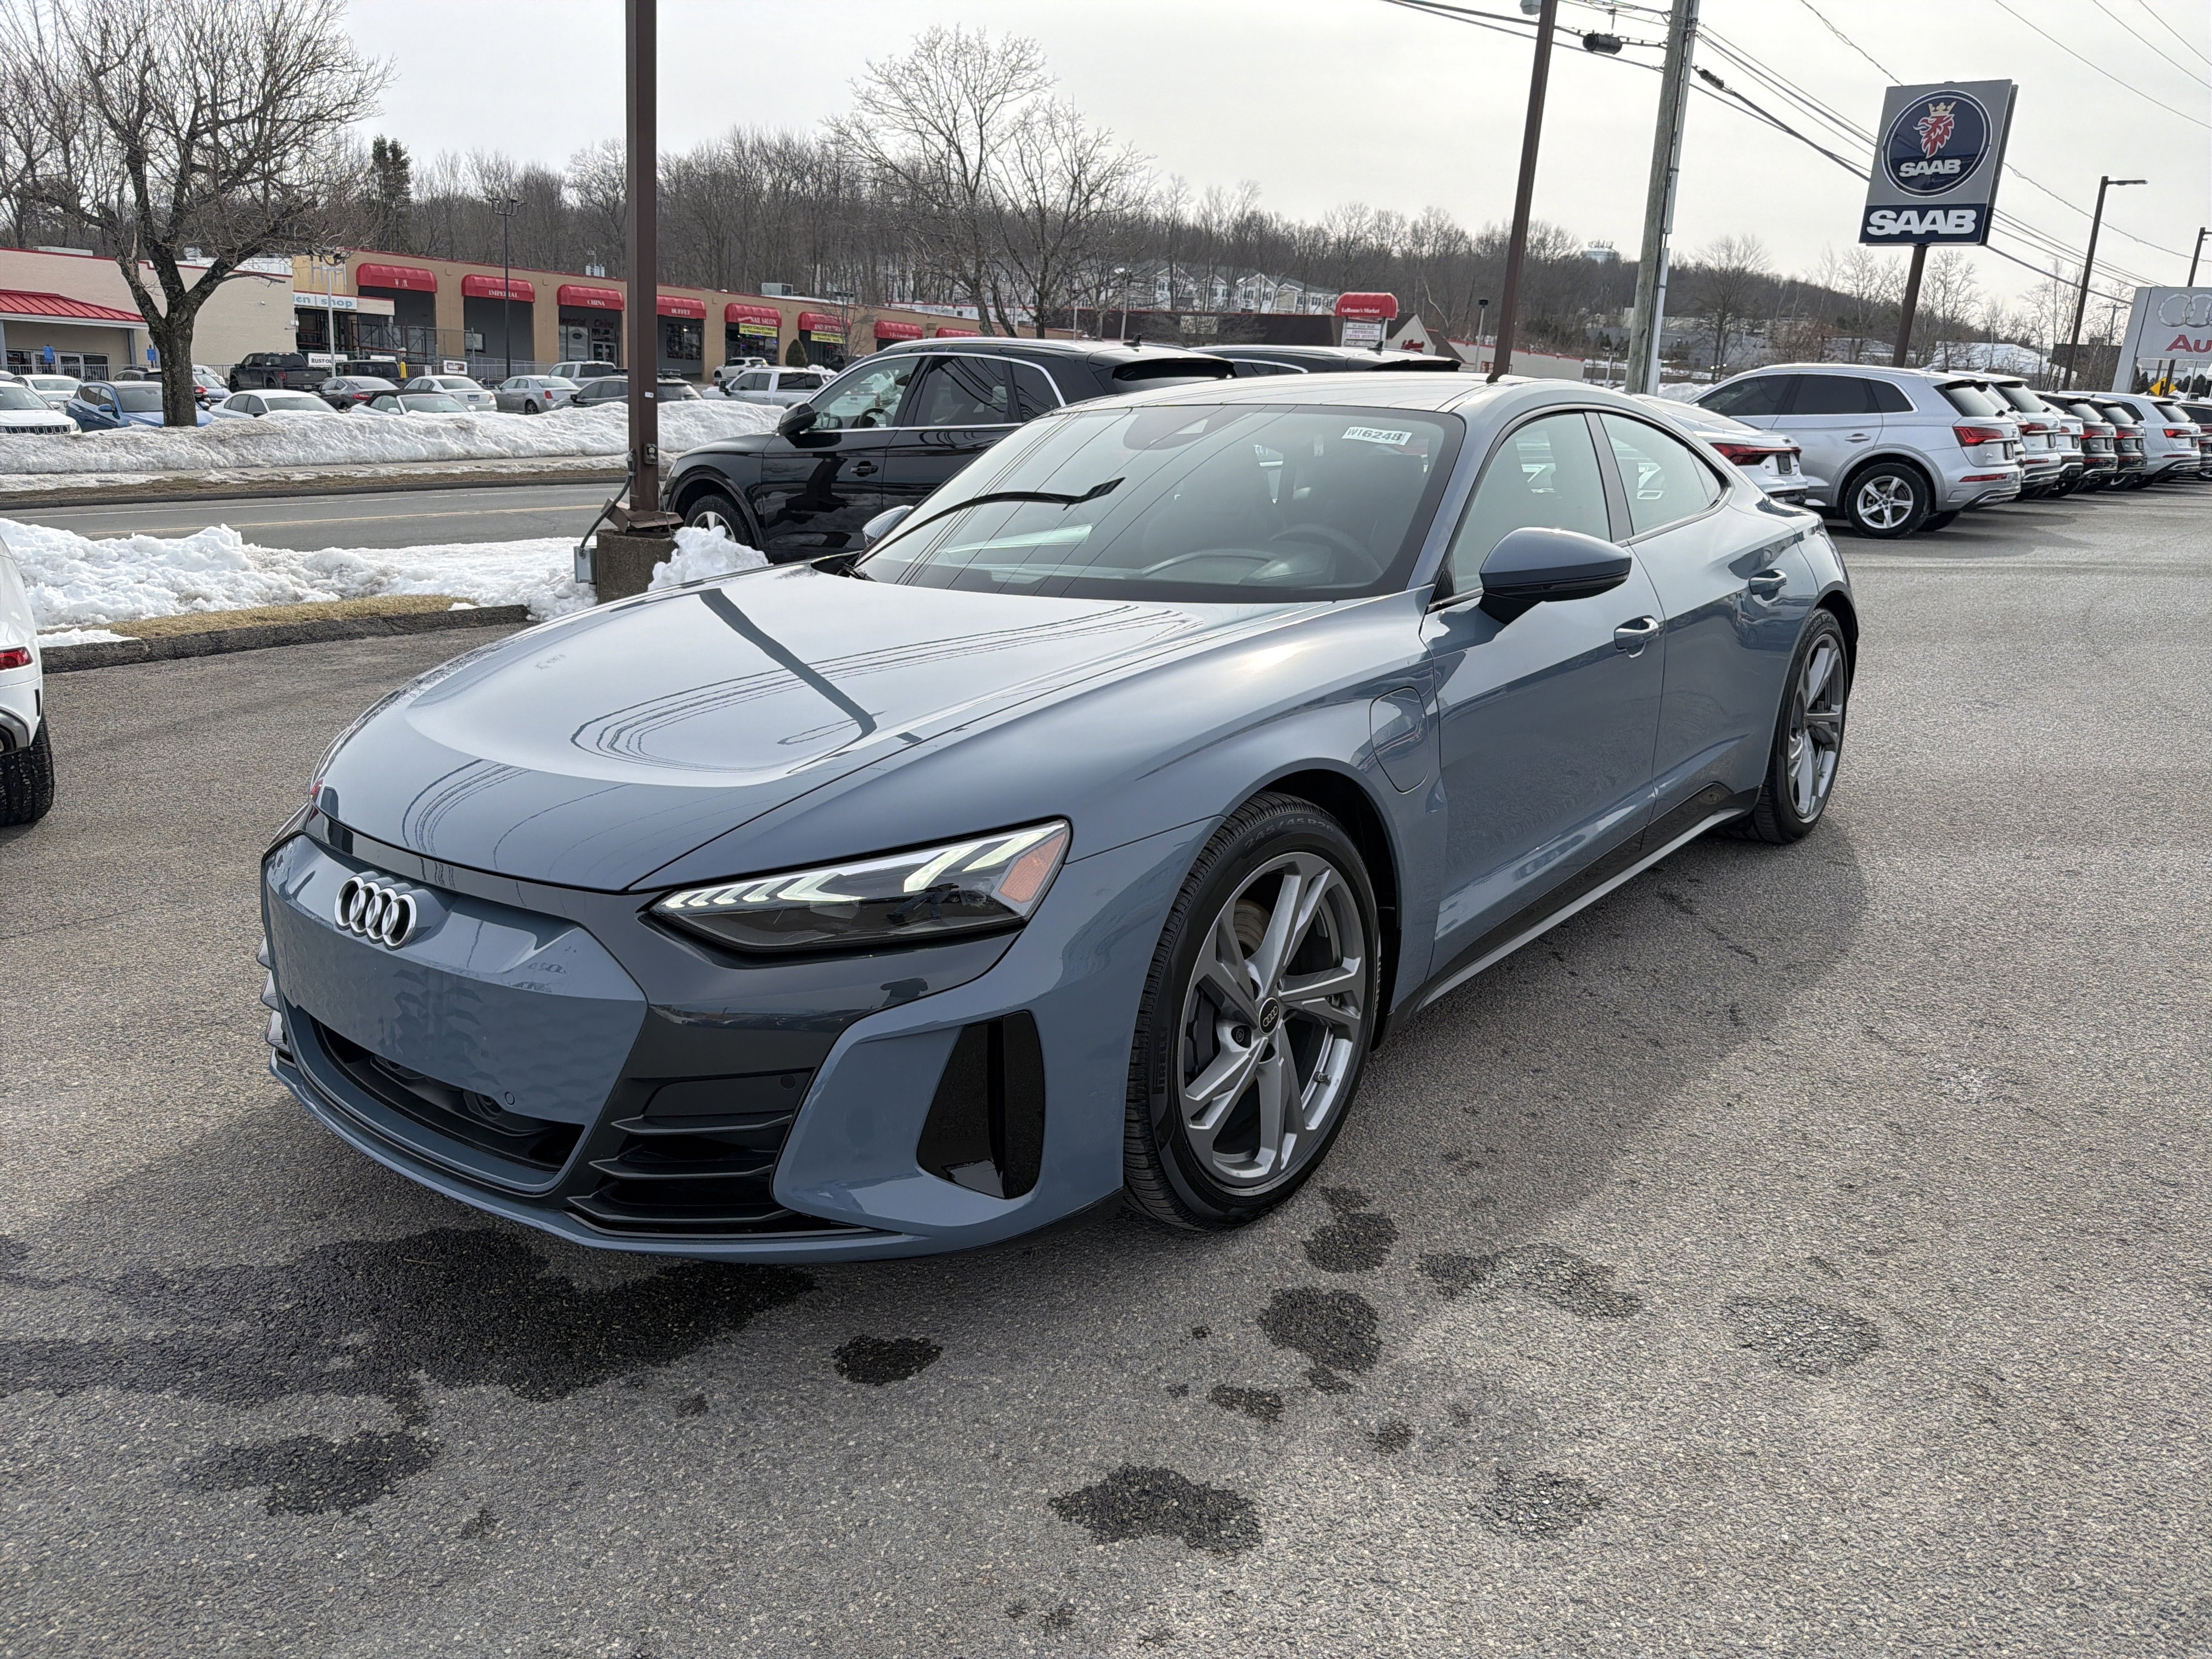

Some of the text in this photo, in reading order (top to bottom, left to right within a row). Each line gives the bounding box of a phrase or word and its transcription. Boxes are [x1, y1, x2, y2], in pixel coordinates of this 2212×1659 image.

[1899, 159, 1961, 177] SAAB
[1866, 210, 1977, 236] SAAB
[1244, 818, 1334, 850] 245/45 R20
